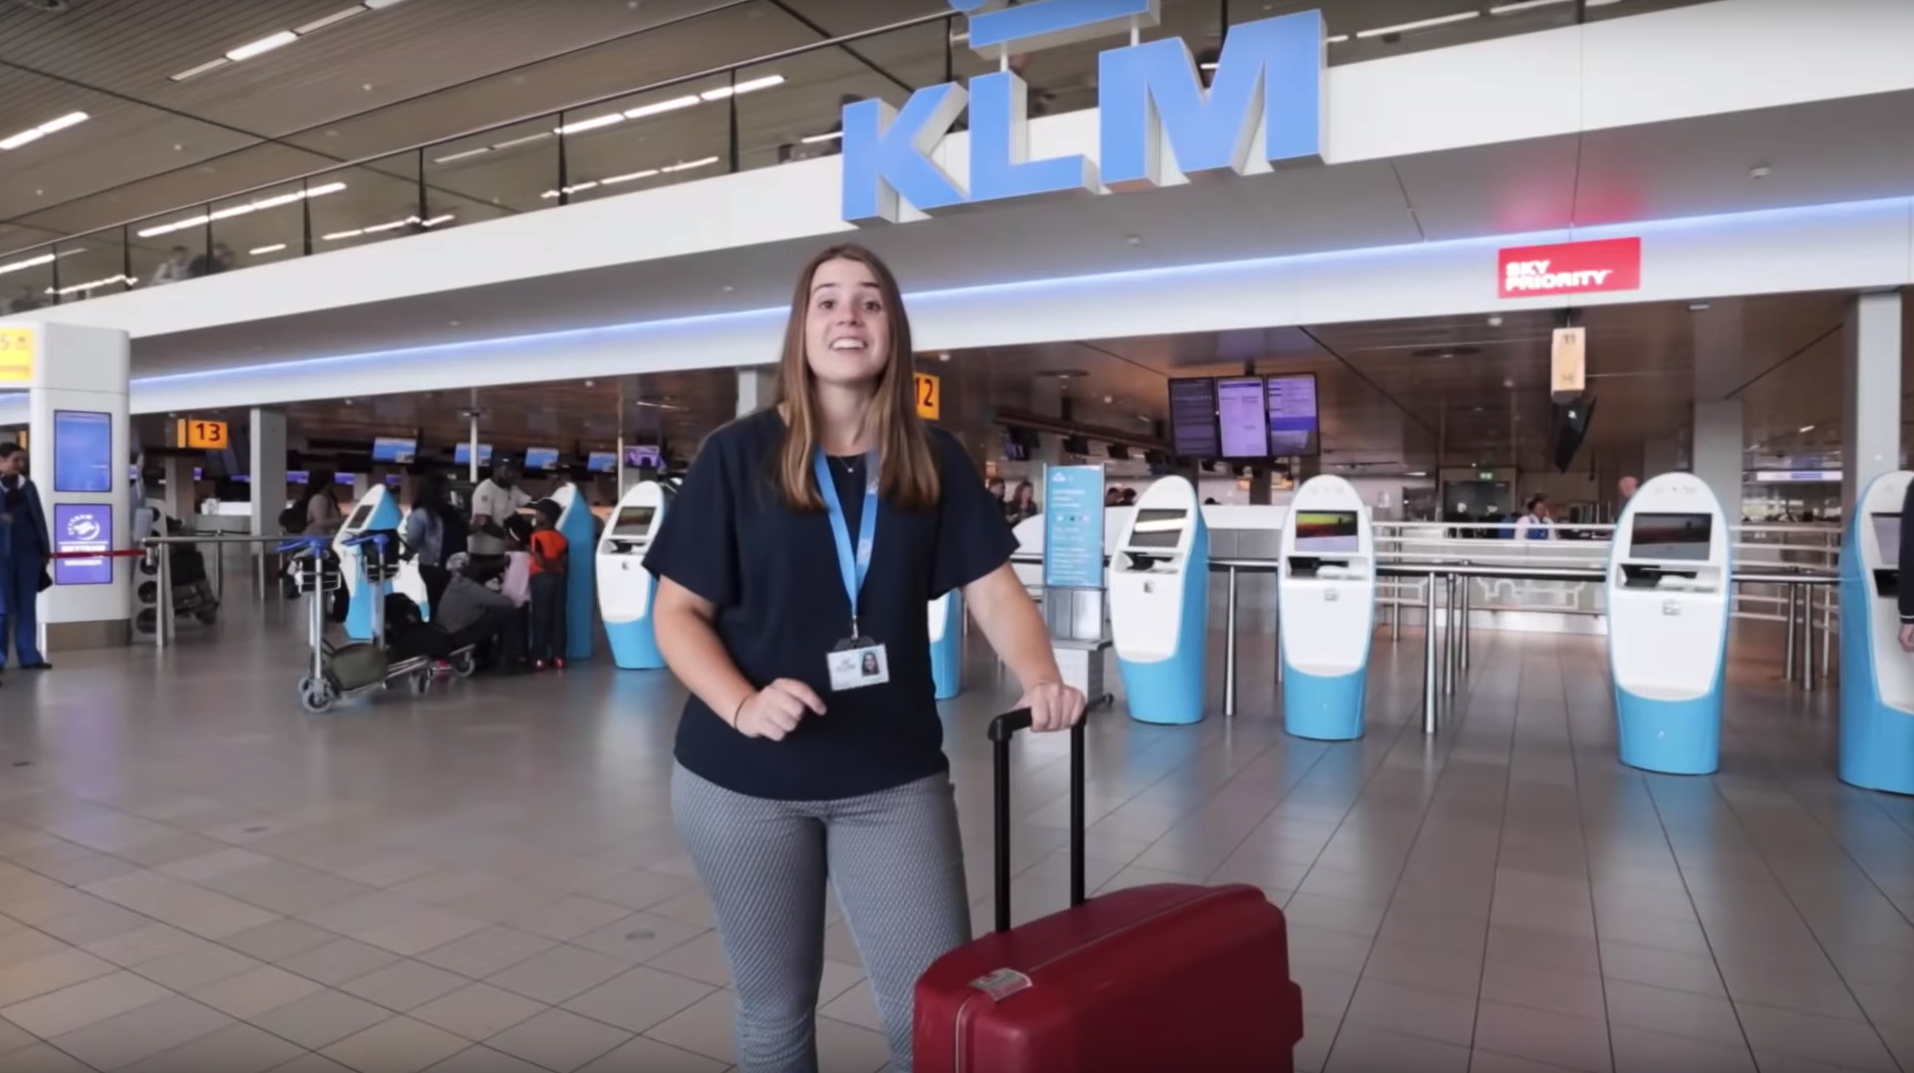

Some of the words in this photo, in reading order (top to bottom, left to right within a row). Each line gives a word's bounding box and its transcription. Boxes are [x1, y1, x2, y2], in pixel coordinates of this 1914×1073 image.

[843, 9, 1323, 221] KLM
[1506, 260, 1550, 277] SKY
[1506, 271, 1609, 291] PRIORITY
[915, 377, 934, 407] 12
[196, 422, 221, 442] 13
